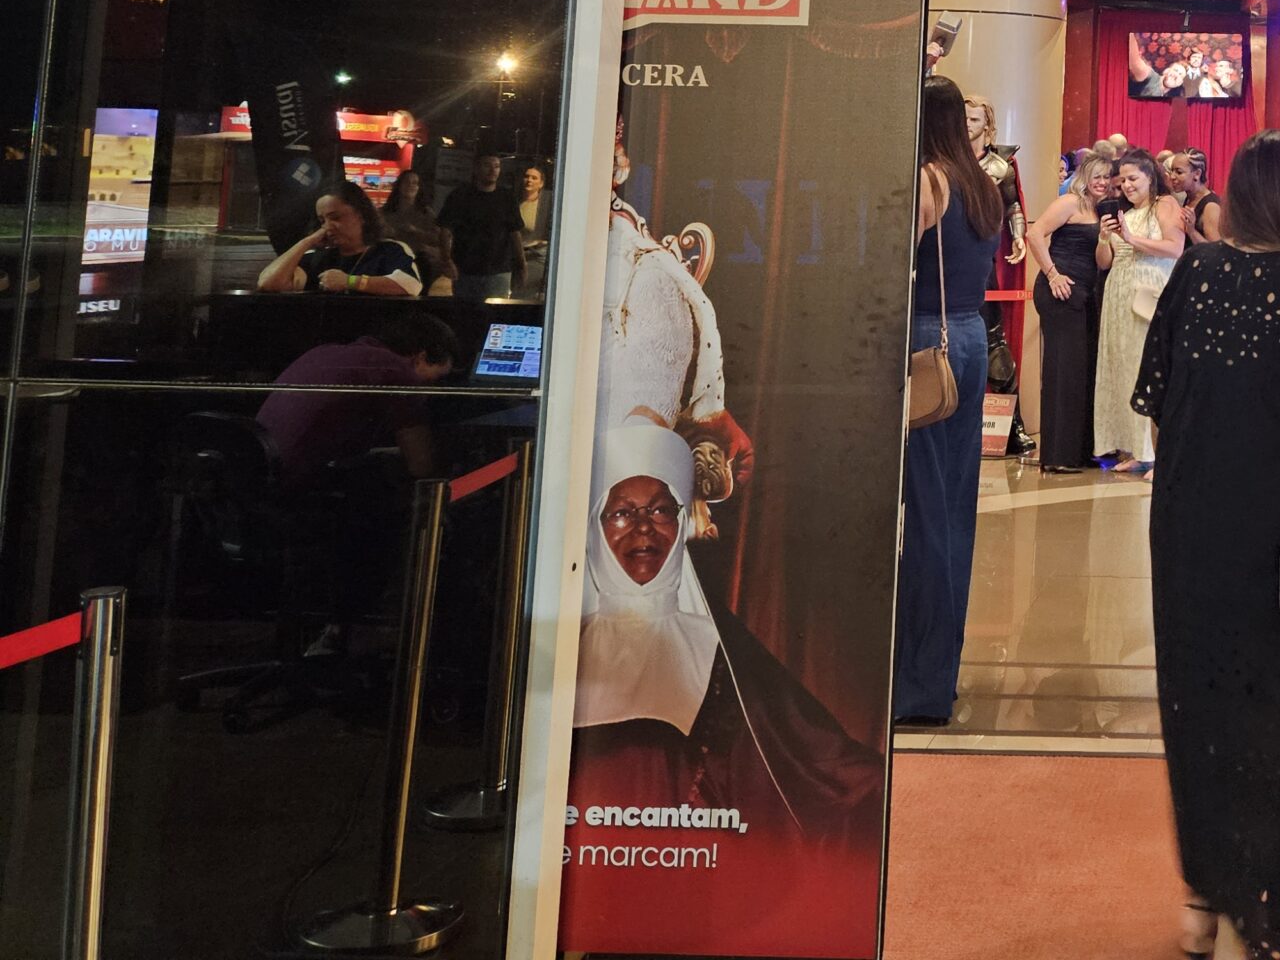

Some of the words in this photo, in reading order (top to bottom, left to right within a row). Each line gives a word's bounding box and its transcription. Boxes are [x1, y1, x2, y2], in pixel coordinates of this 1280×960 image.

[621, 63, 709, 88] CERA
[584, 803, 749, 834] encantam,
[578, 842, 719, 869] marcam!
